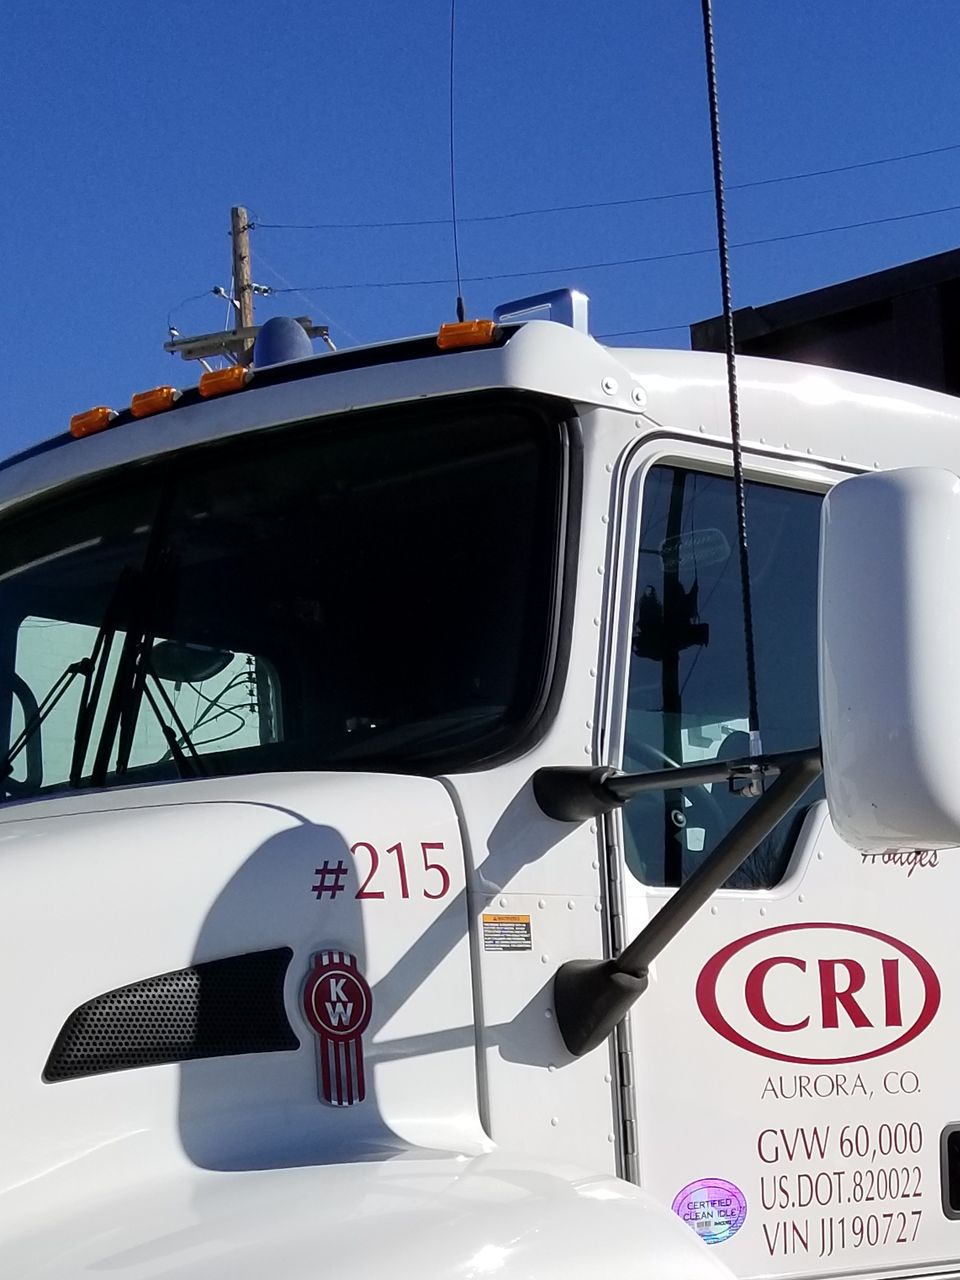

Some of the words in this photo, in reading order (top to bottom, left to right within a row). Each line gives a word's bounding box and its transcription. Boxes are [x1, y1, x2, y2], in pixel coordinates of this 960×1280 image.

[311, 841, 451, 900] #215
[329, 978, 348, 1002] K
[744, 956, 904, 1033] CRI
[324, 1002, 353, 1027] W
[761, 1073, 874, 1100] AURORA,
[883, 1071, 921, 1095] CO.
[757, 1125, 830, 1164] GVW
[839, 1121, 923, 1163] 60,000
[686, 1198, 732, 1210] CERTIFIED
[760, 1166, 923, 1211] US.DOT.820022
[683, 1210, 714, 1221] CLEAN
[717, 1208, 737, 1218] IDLE
[762, 1219, 809, 1256] VIN
[818, 1210, 922, 1258] JJ190727
